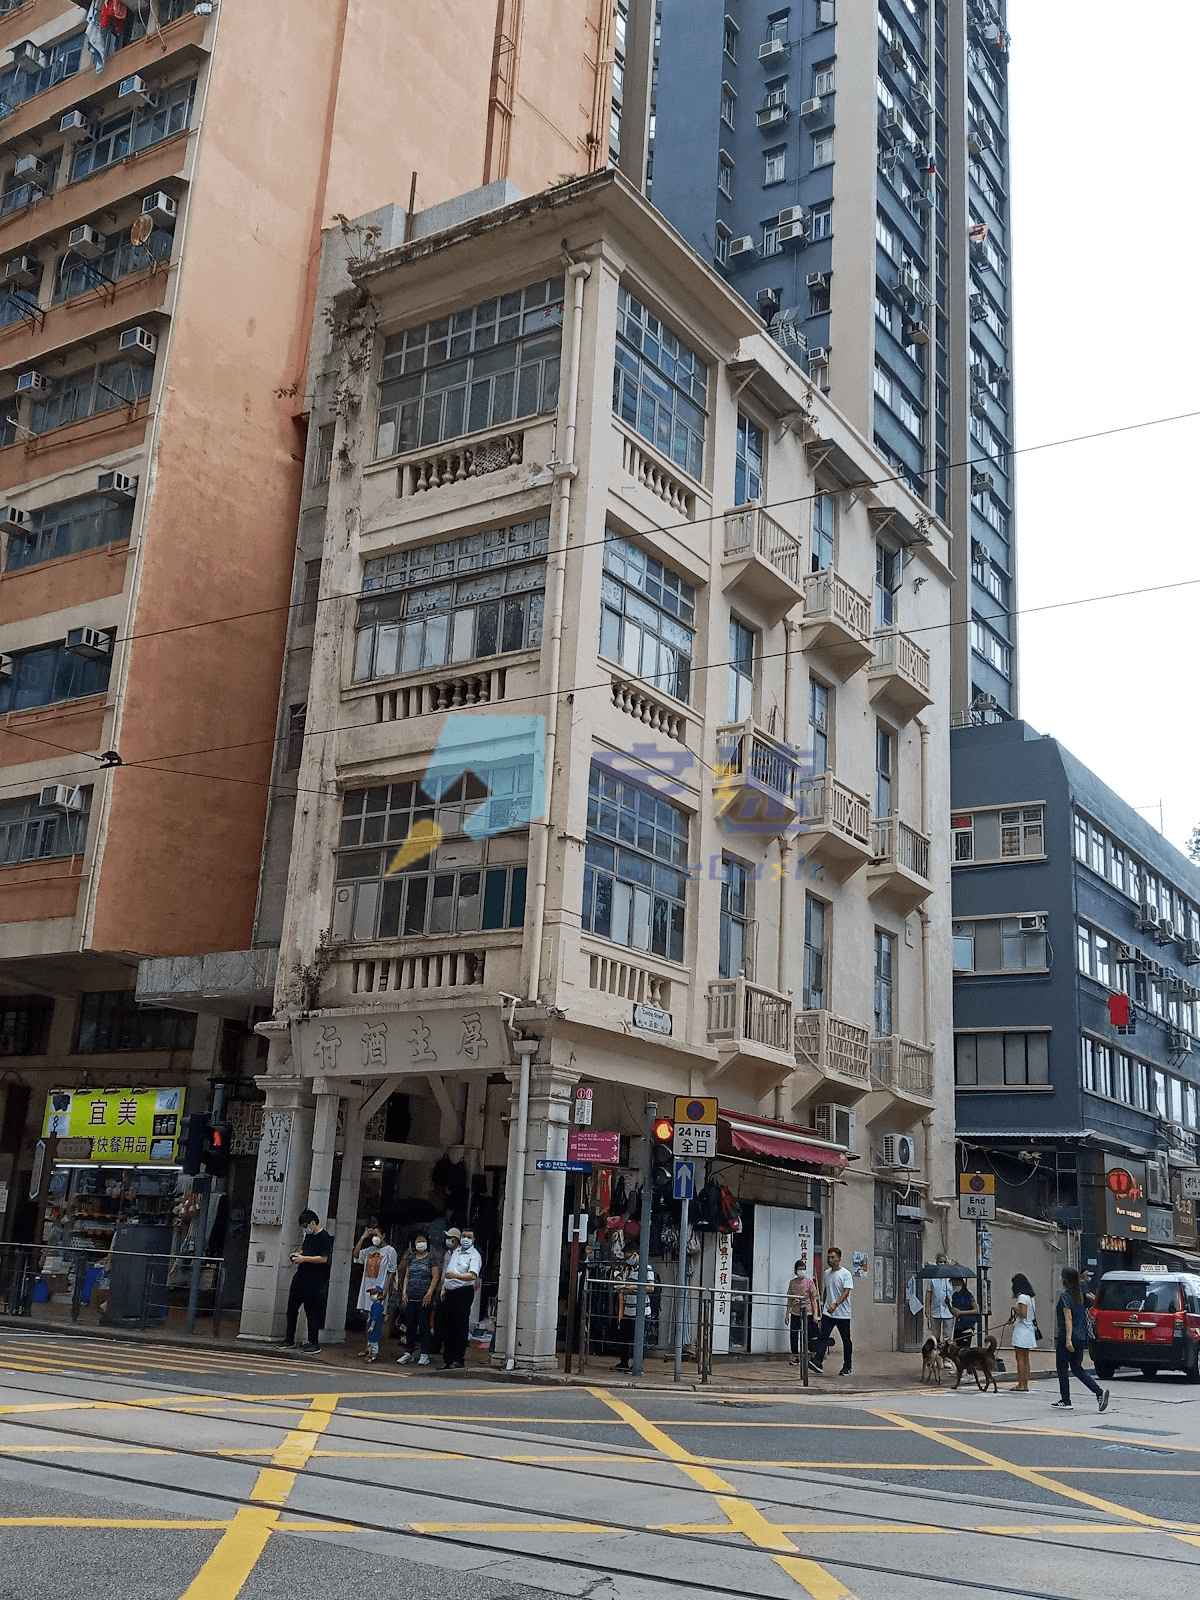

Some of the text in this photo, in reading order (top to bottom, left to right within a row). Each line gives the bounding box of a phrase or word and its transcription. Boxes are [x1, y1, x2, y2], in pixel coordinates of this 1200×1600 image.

[88, 1098, 138, 1125] 宜美
[270, 1116, 282, 1127] Vi
[269, 1128, 281, 1140] Vi
[678, 1127, 711, 1138] 24 hrs
[682, 1139, 707, 1154] 全日
[969, 1197, 986, 1205] End
[966, 1206, 989, 1217] 終止
